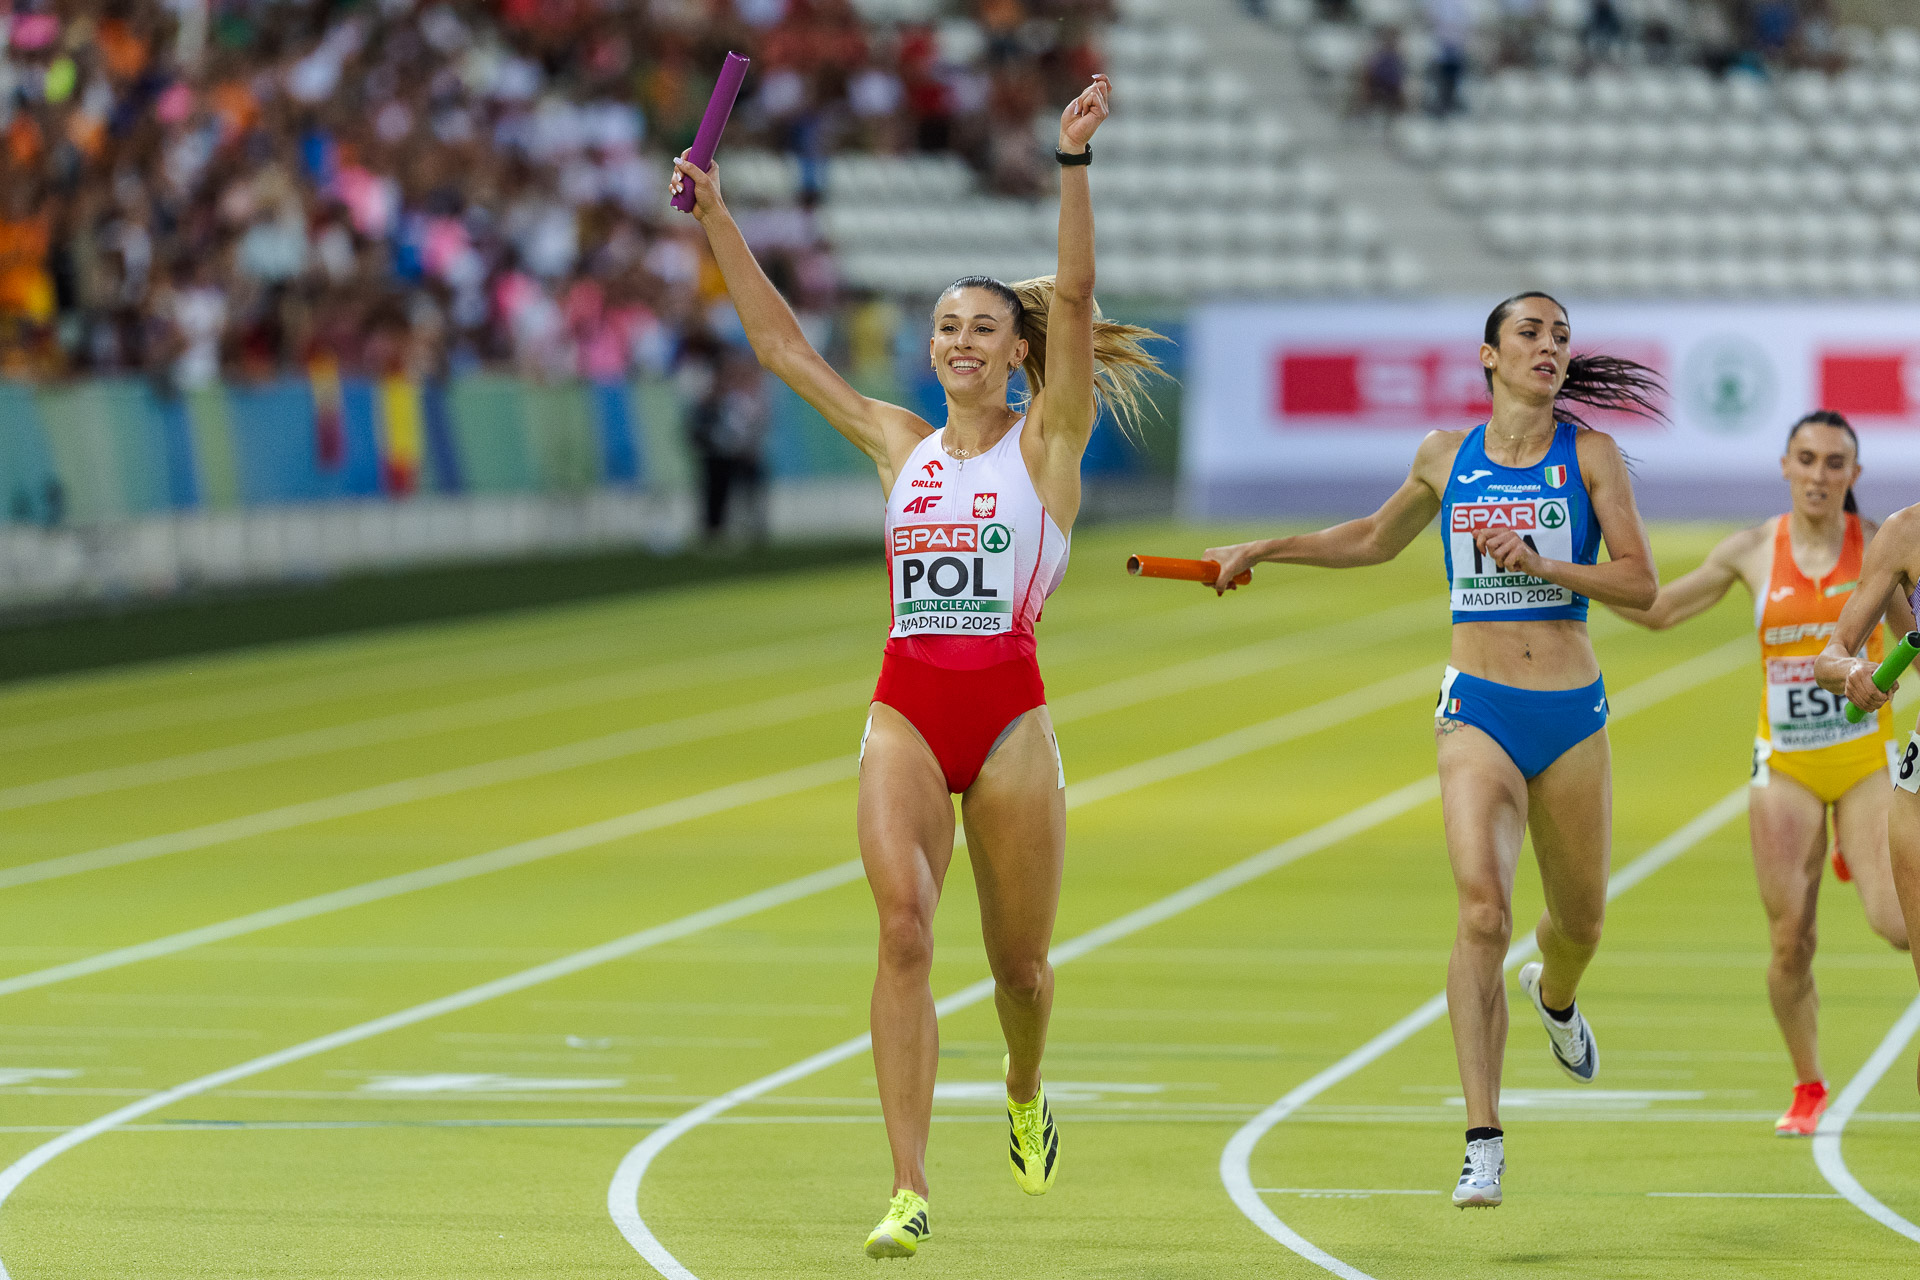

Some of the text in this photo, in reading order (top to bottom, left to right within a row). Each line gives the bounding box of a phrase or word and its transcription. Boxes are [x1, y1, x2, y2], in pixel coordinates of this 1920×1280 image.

[911, 480, 942, 488] ORLEN
[1453, 506, 1534, 529] SPAR
[894, 527, 975, 551] SPAR
[902, 556, 998, 599] POL
[1504, 575, 1543, 586] CLEAN
[1462, 588, 1563, 606] MADRID 2025
[900, 616, 1001, 632] MADRID 2025
[1899, 741, 1919, 780] 8
